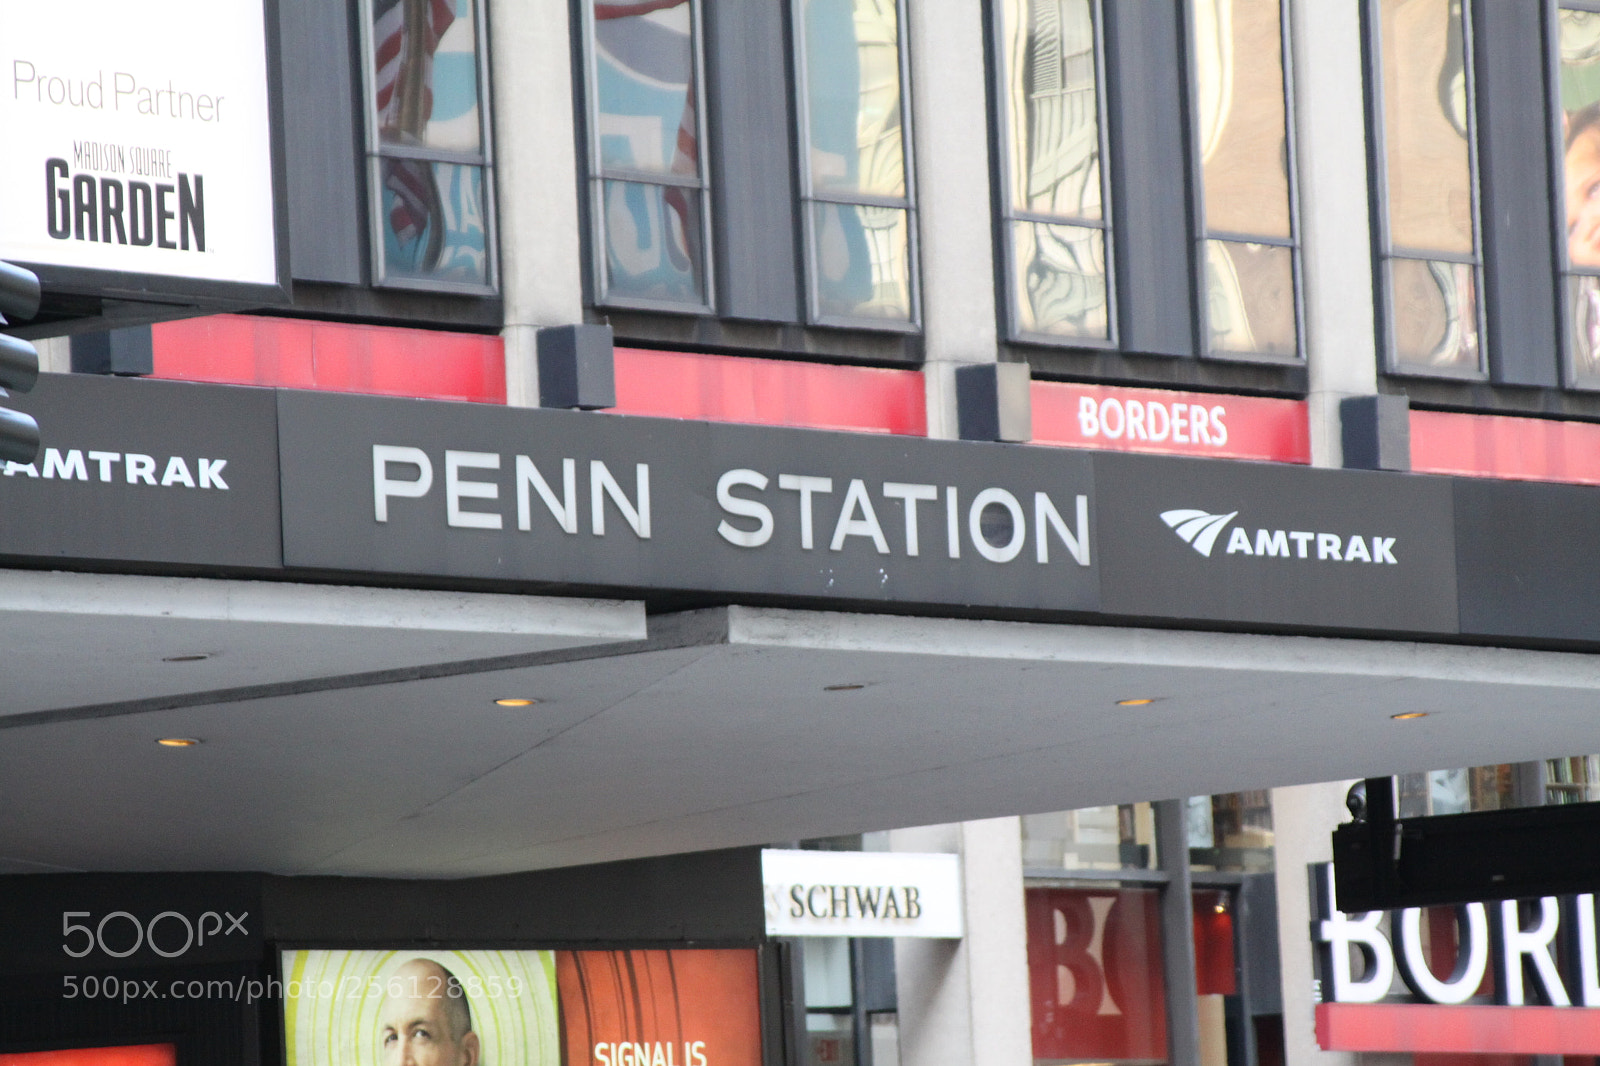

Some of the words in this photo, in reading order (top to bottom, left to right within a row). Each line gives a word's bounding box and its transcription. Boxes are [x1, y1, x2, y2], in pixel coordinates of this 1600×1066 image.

[13, 59, 104, 110] Proud
[114, 71, 225, 122] Partner
[73, 139, 126, 174] MADISON
[129, 146, 172, 178] SQUARE
[45, 156, 206, 253] GARDEN
[1078, 396, 1228, 446] BORDERS
[372, 444, 651, 540] PENN
[715, 468, 1092, 567] STATION
[1226, 526, 1398, 564] AMTRAK
[789, 884, 922, 920] SCHWAB
[594, 1041, 680, 1066] SIGNAL
[685, 1041, 708, 1066] IS
